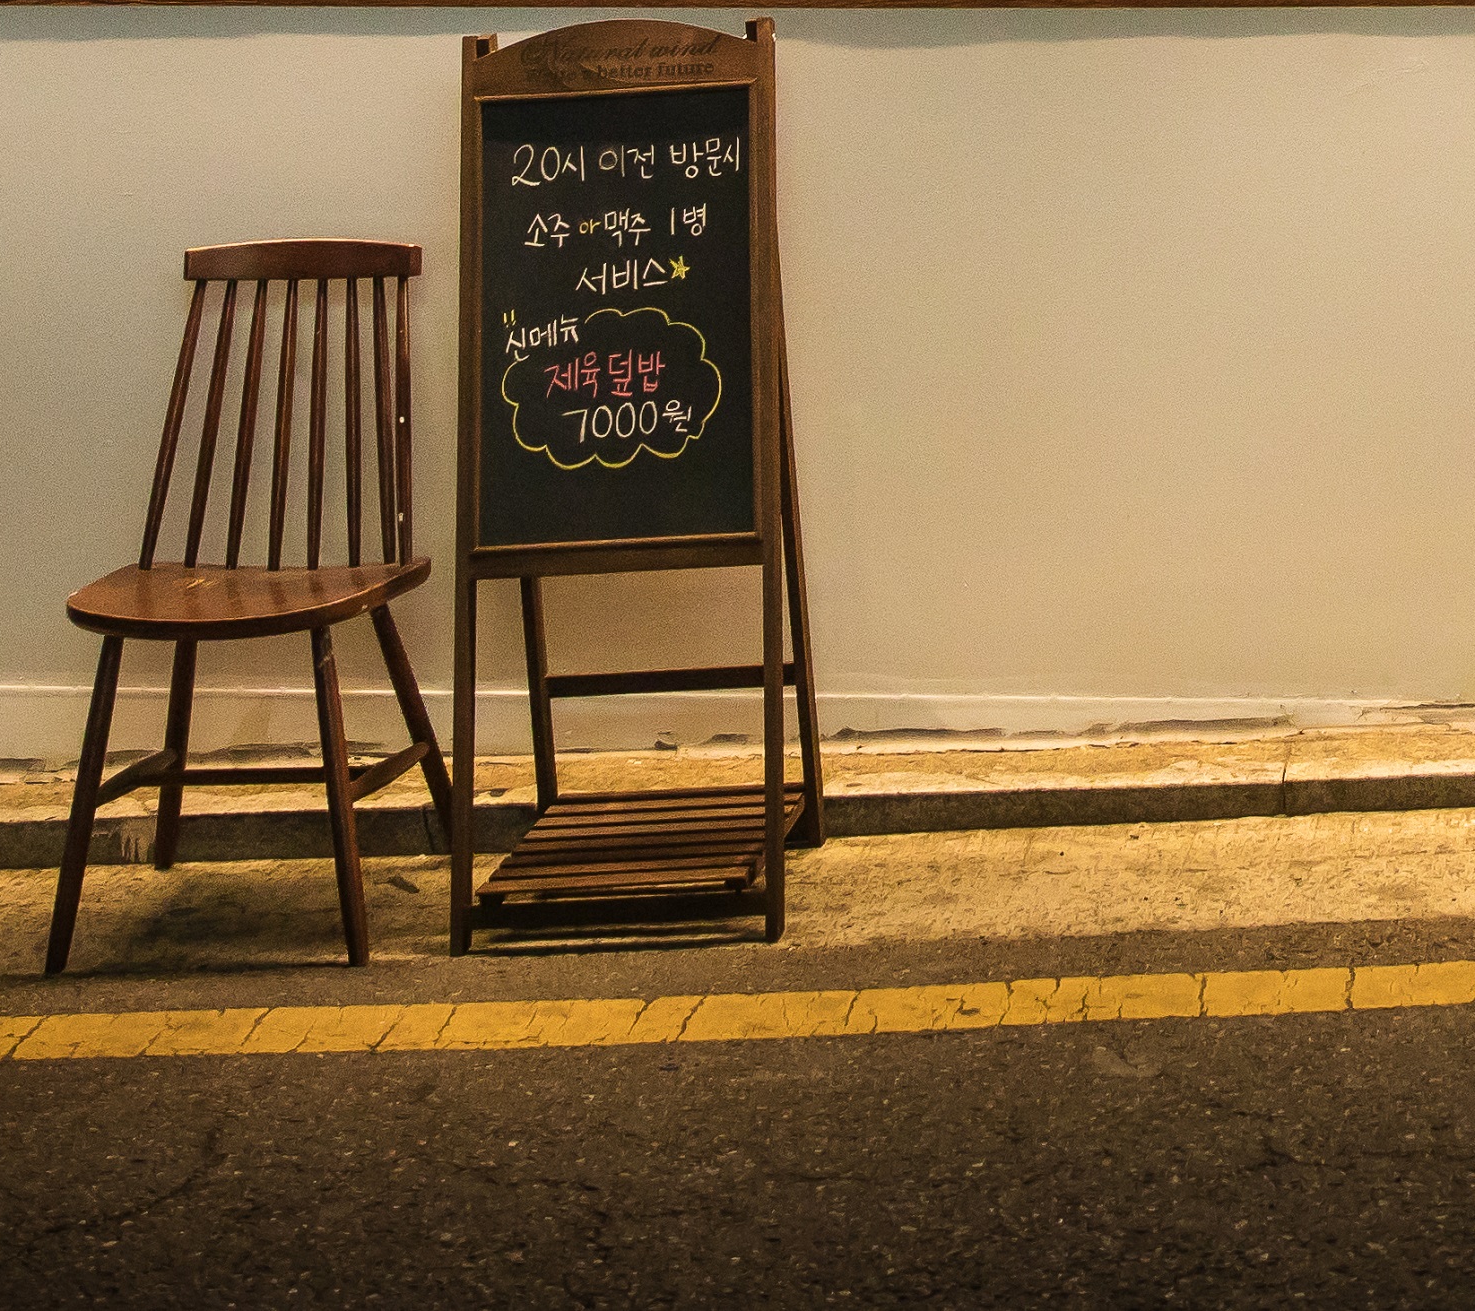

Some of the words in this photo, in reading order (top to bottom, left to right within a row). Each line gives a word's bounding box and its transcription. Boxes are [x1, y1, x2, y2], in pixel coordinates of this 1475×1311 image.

[596, 63, 653, 79] better
[658, 61, 715, 76] future
[511, 143, 586, 187] 20시
[598, 144, 656, 179] 이전
[670, 136, 741, 179] 방문시
[524, 212, 571, 248] 소주
[602, 211, 651, 248] 맥주
[575, 257, 669, 297] 서비스
[505, 314, 579, 361] 신메뉴
[562, 400, 693, 443] 7000원
